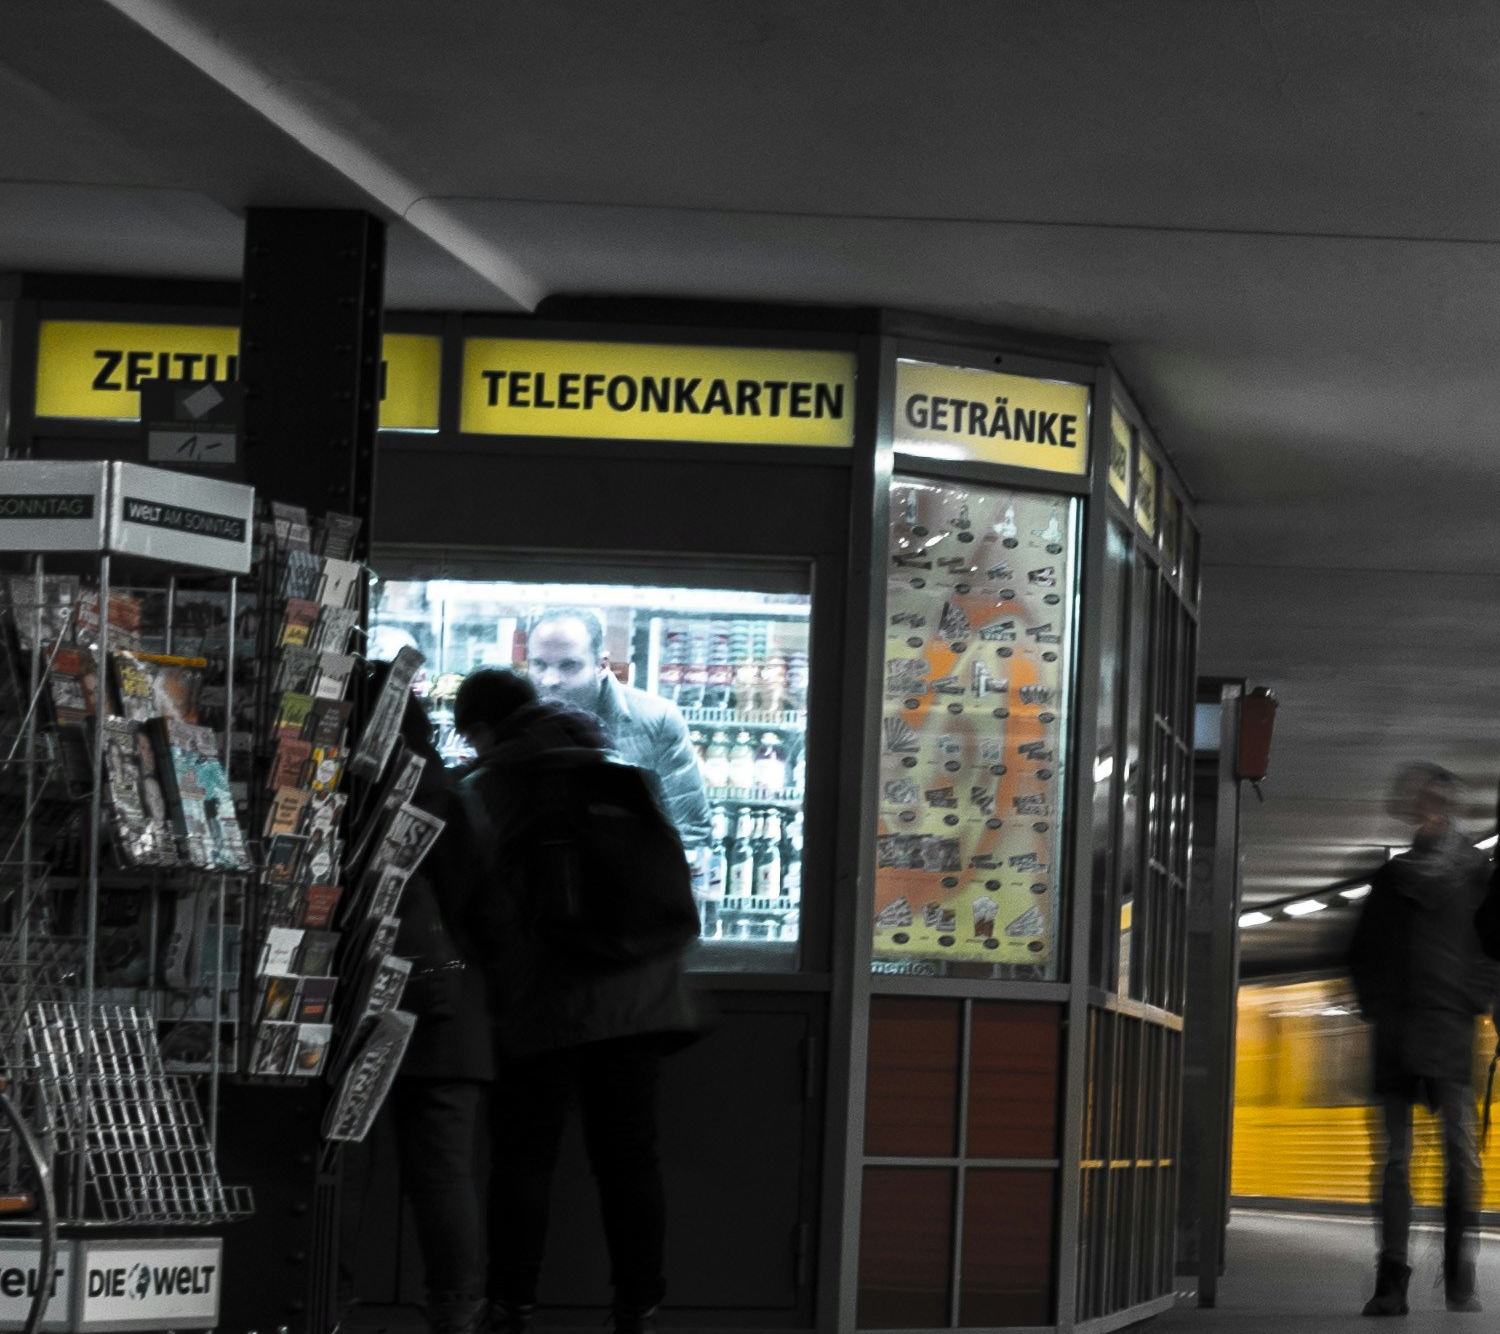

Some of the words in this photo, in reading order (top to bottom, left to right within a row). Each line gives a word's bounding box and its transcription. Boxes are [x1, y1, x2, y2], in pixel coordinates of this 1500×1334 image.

[482, 370, 844, 419] TELEFONKARTEN
[905, 393, 1077, 448] GETRÄNKE
[163, 508, 183, 526] AM
[184, 510, 241, 538] SONNTAG
[88, 1268, 126, 1298] DIE
